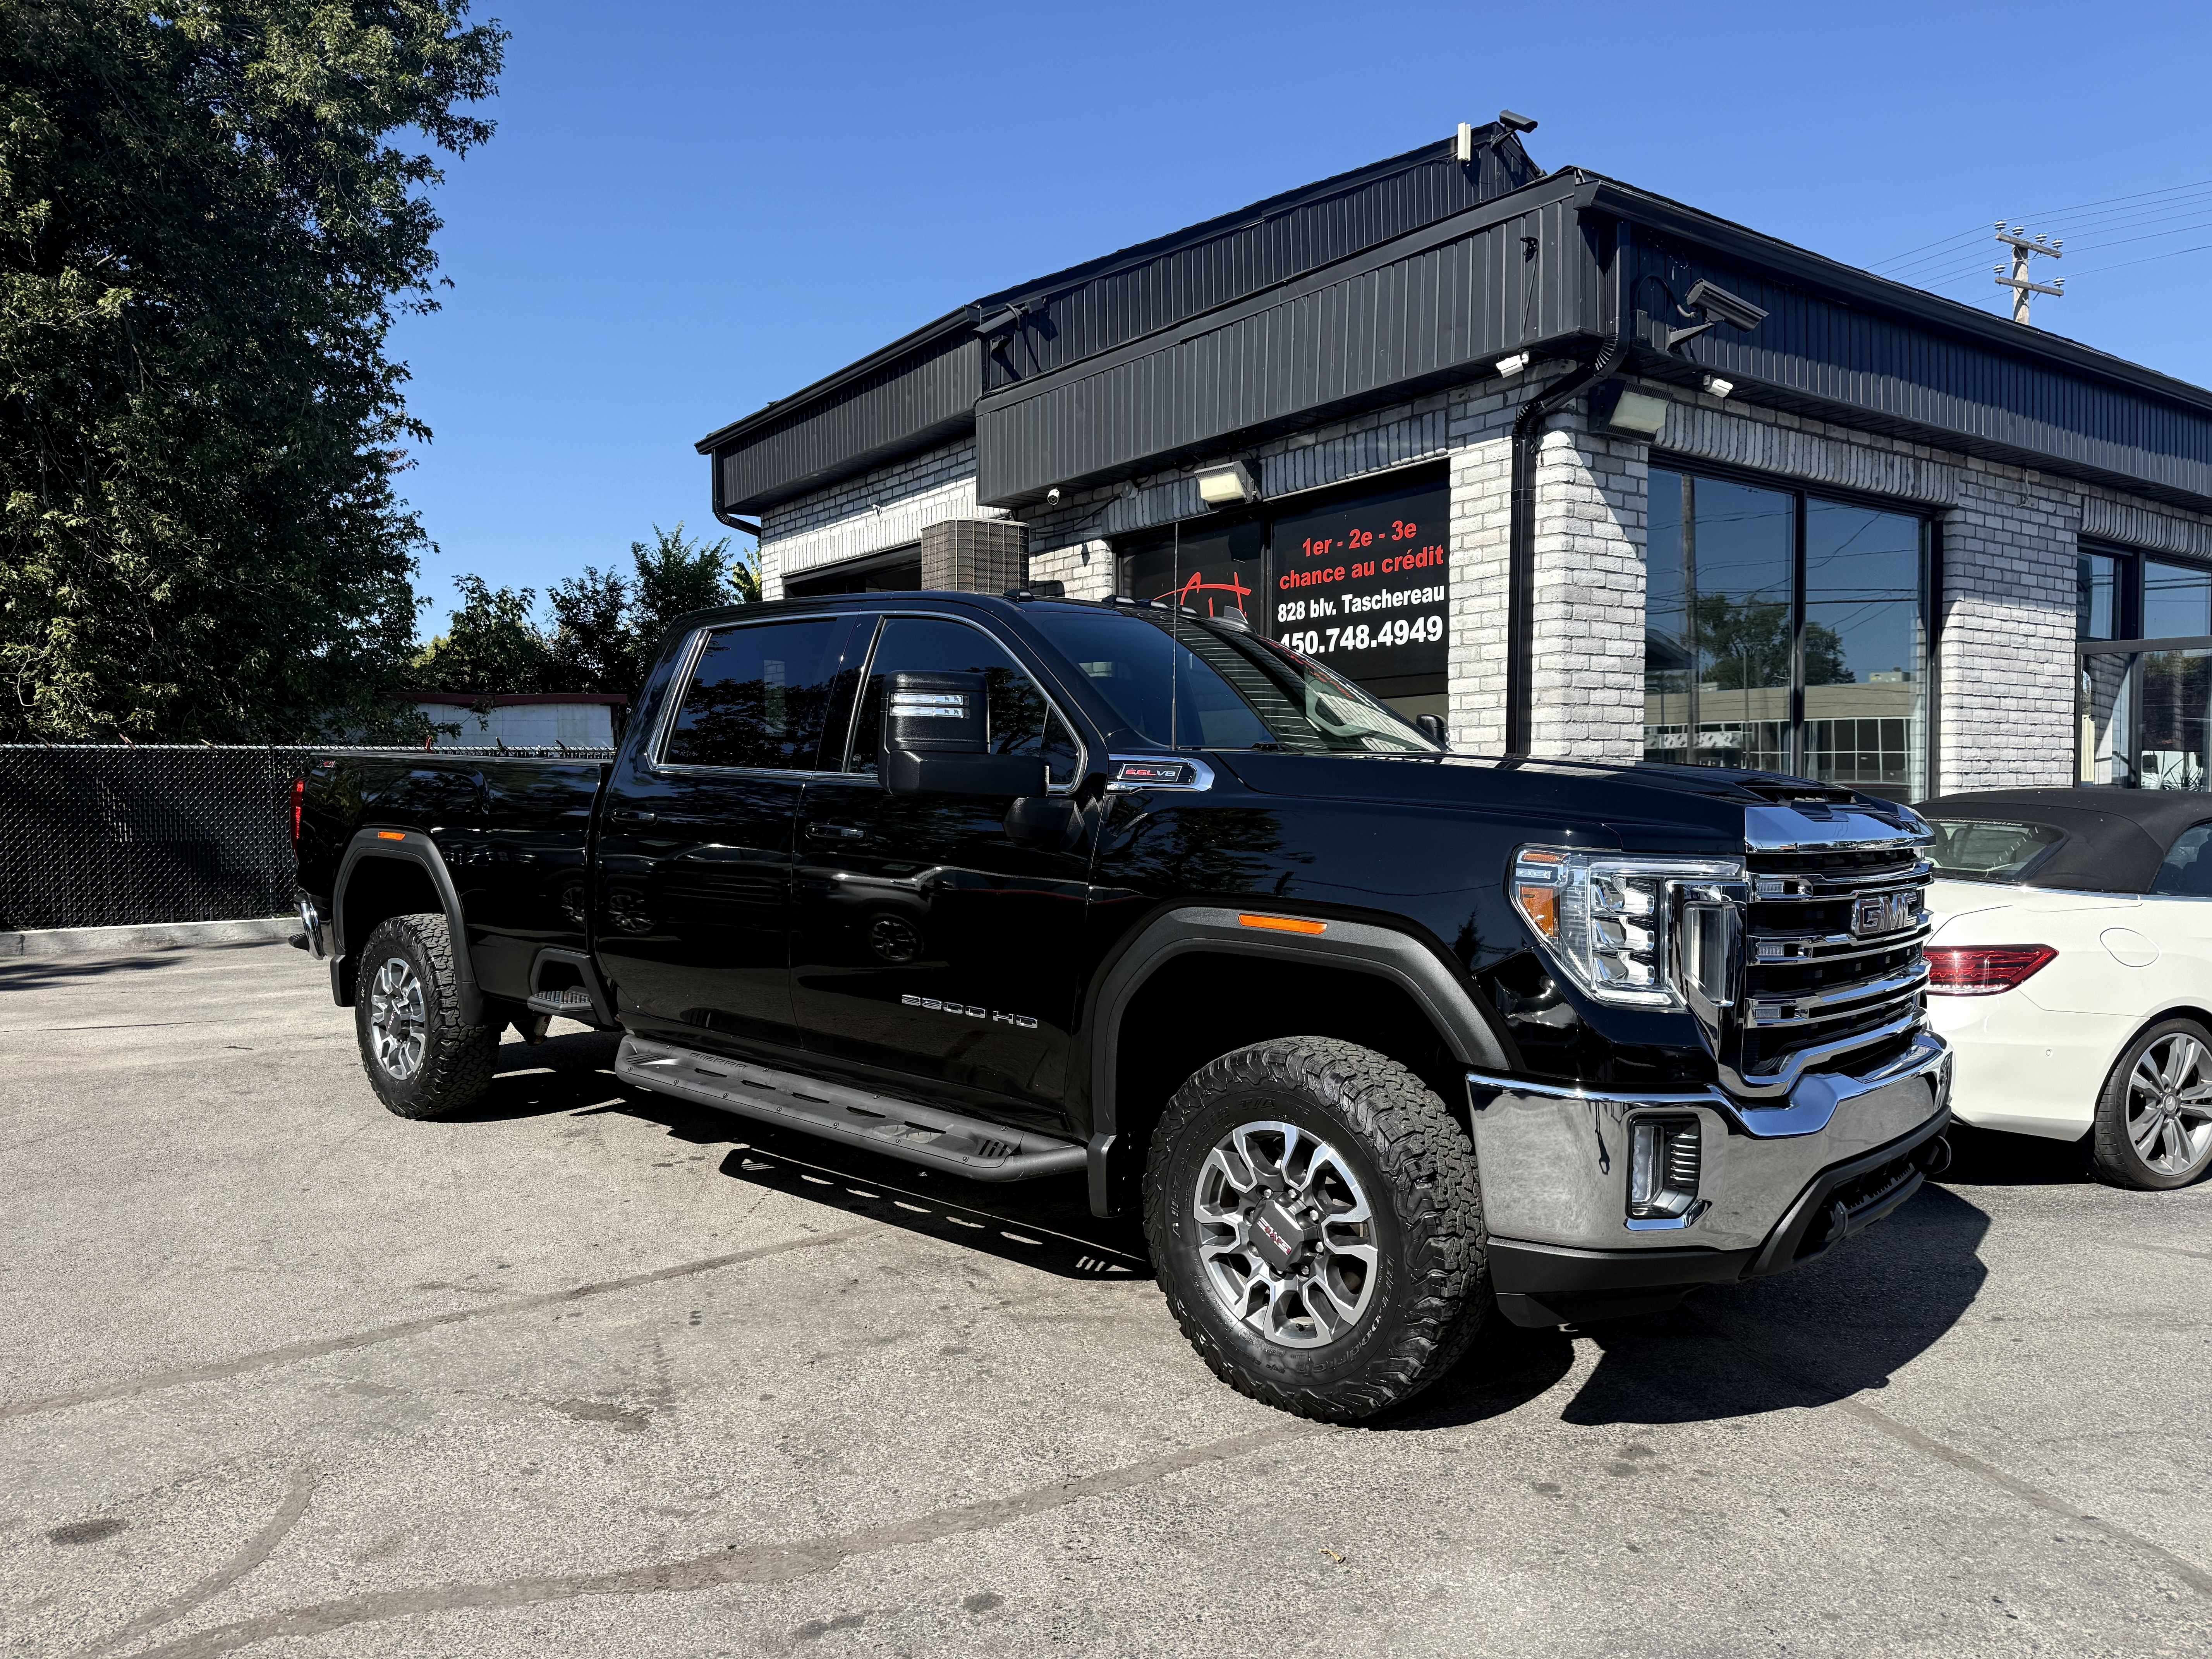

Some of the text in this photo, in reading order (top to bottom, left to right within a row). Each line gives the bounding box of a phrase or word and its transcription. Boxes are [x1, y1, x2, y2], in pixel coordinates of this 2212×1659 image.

[1302, 538, 1332, 557] 1er
[1349, 529, 1372, 549] 2e
[1391, 520, 1417, 541] 3e
[1279, 544, 1444, 589] chance au crédit
[1278, 585, 1444, 622] 828 blv. Taschereau
[1280, 615, 1443, 655] 450.748.4949
[1852, 891, 1917, 934] GMC
[992, 1010, 1039, 1029] HD
[689, 1053, 749, 1070] SIERRA
[1257, 1216, 1292, 1255] GMC
